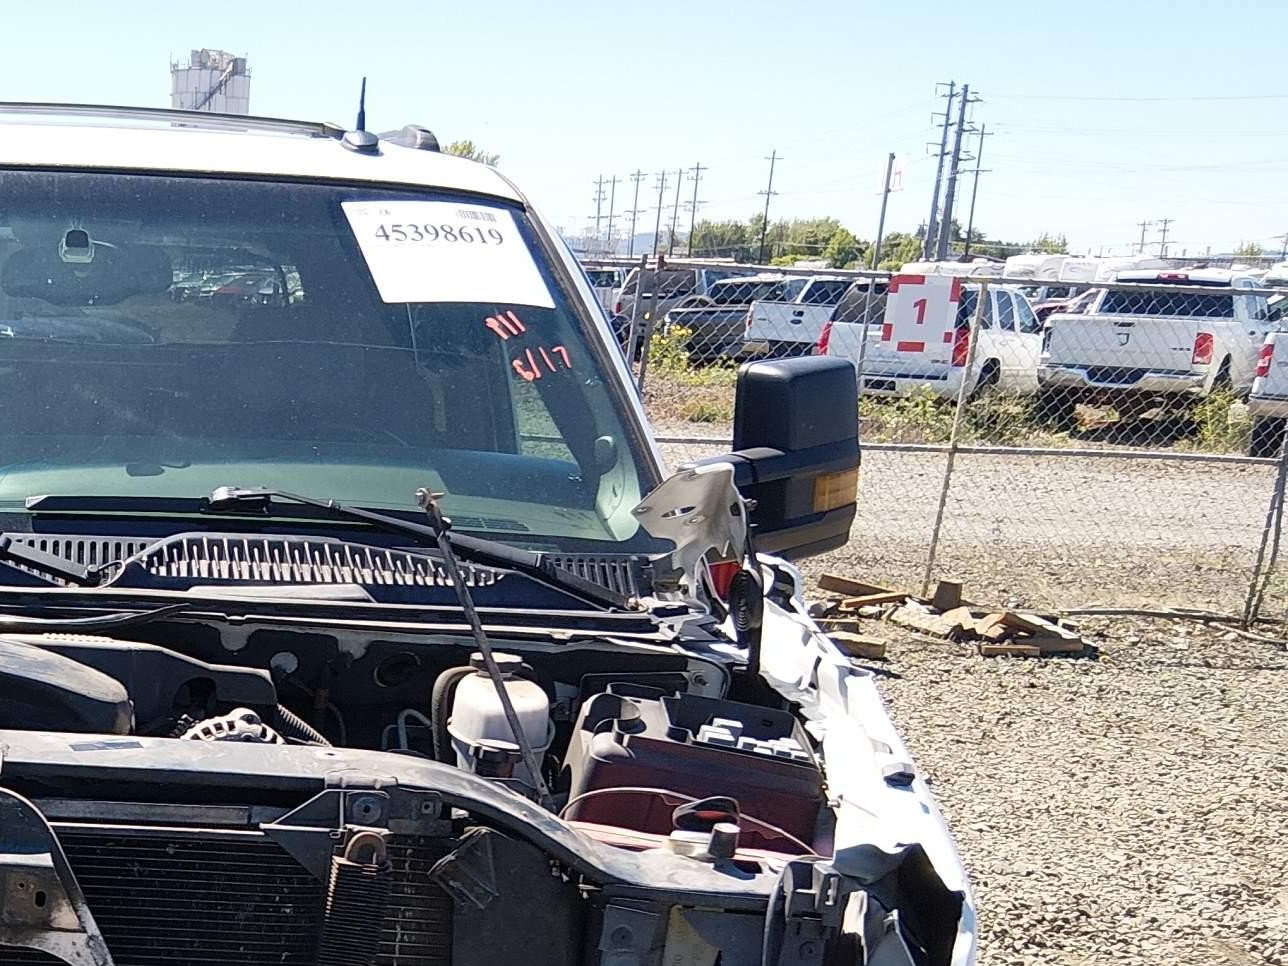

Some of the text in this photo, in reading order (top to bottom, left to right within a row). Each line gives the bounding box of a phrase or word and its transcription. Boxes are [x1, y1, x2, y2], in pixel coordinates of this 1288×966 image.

[375, 223, 504, 246] 45398619
[912, 298, 927, 325] 1
[512, 345, 572, 381] 6/17
